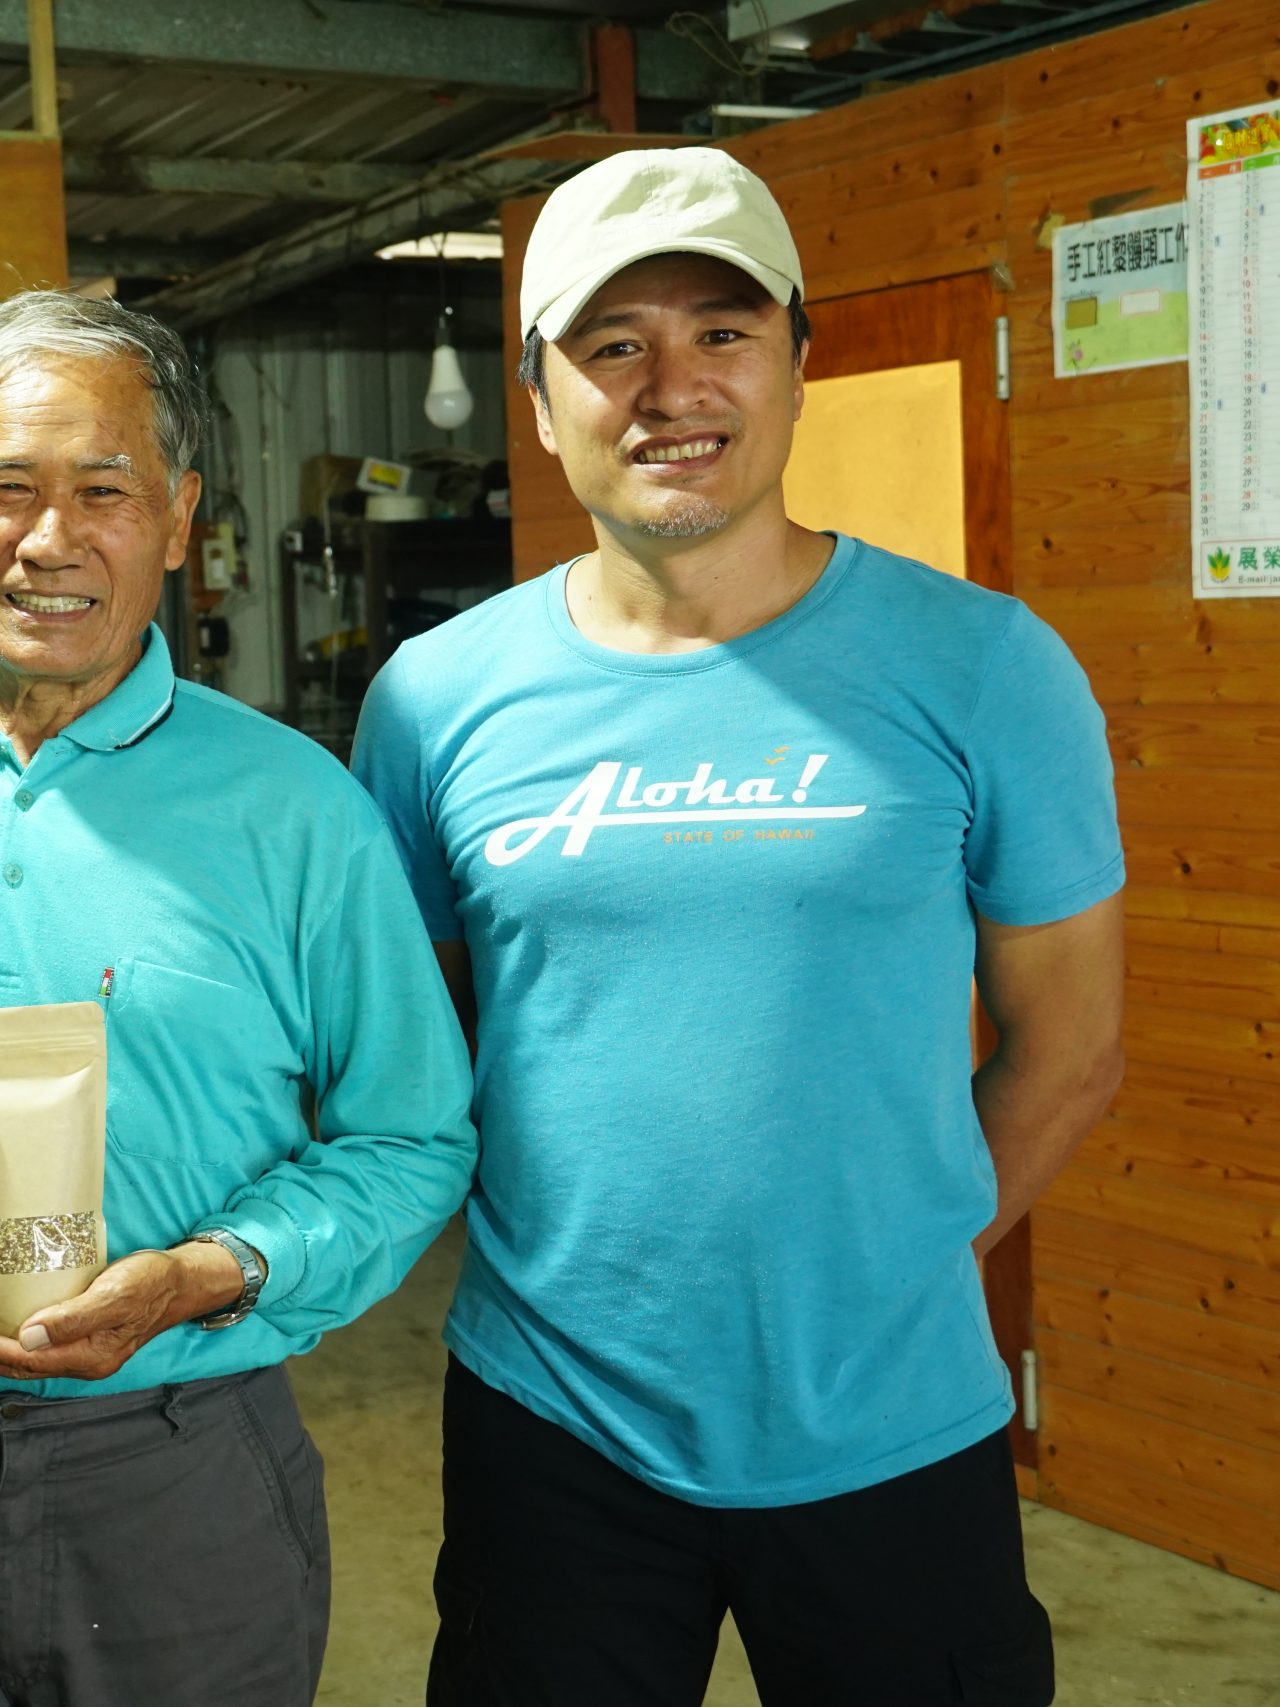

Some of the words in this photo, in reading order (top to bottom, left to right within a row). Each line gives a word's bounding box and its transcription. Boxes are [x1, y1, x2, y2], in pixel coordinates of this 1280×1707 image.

[1238, 545, 1280, 571] 展榮
[1238, 575, 1280, 584] E-mail:ja
[484, 754, 867, 866] Aloha!
[663, 830, 713, 844] STATE
[723, 829, 745, 842] OF
